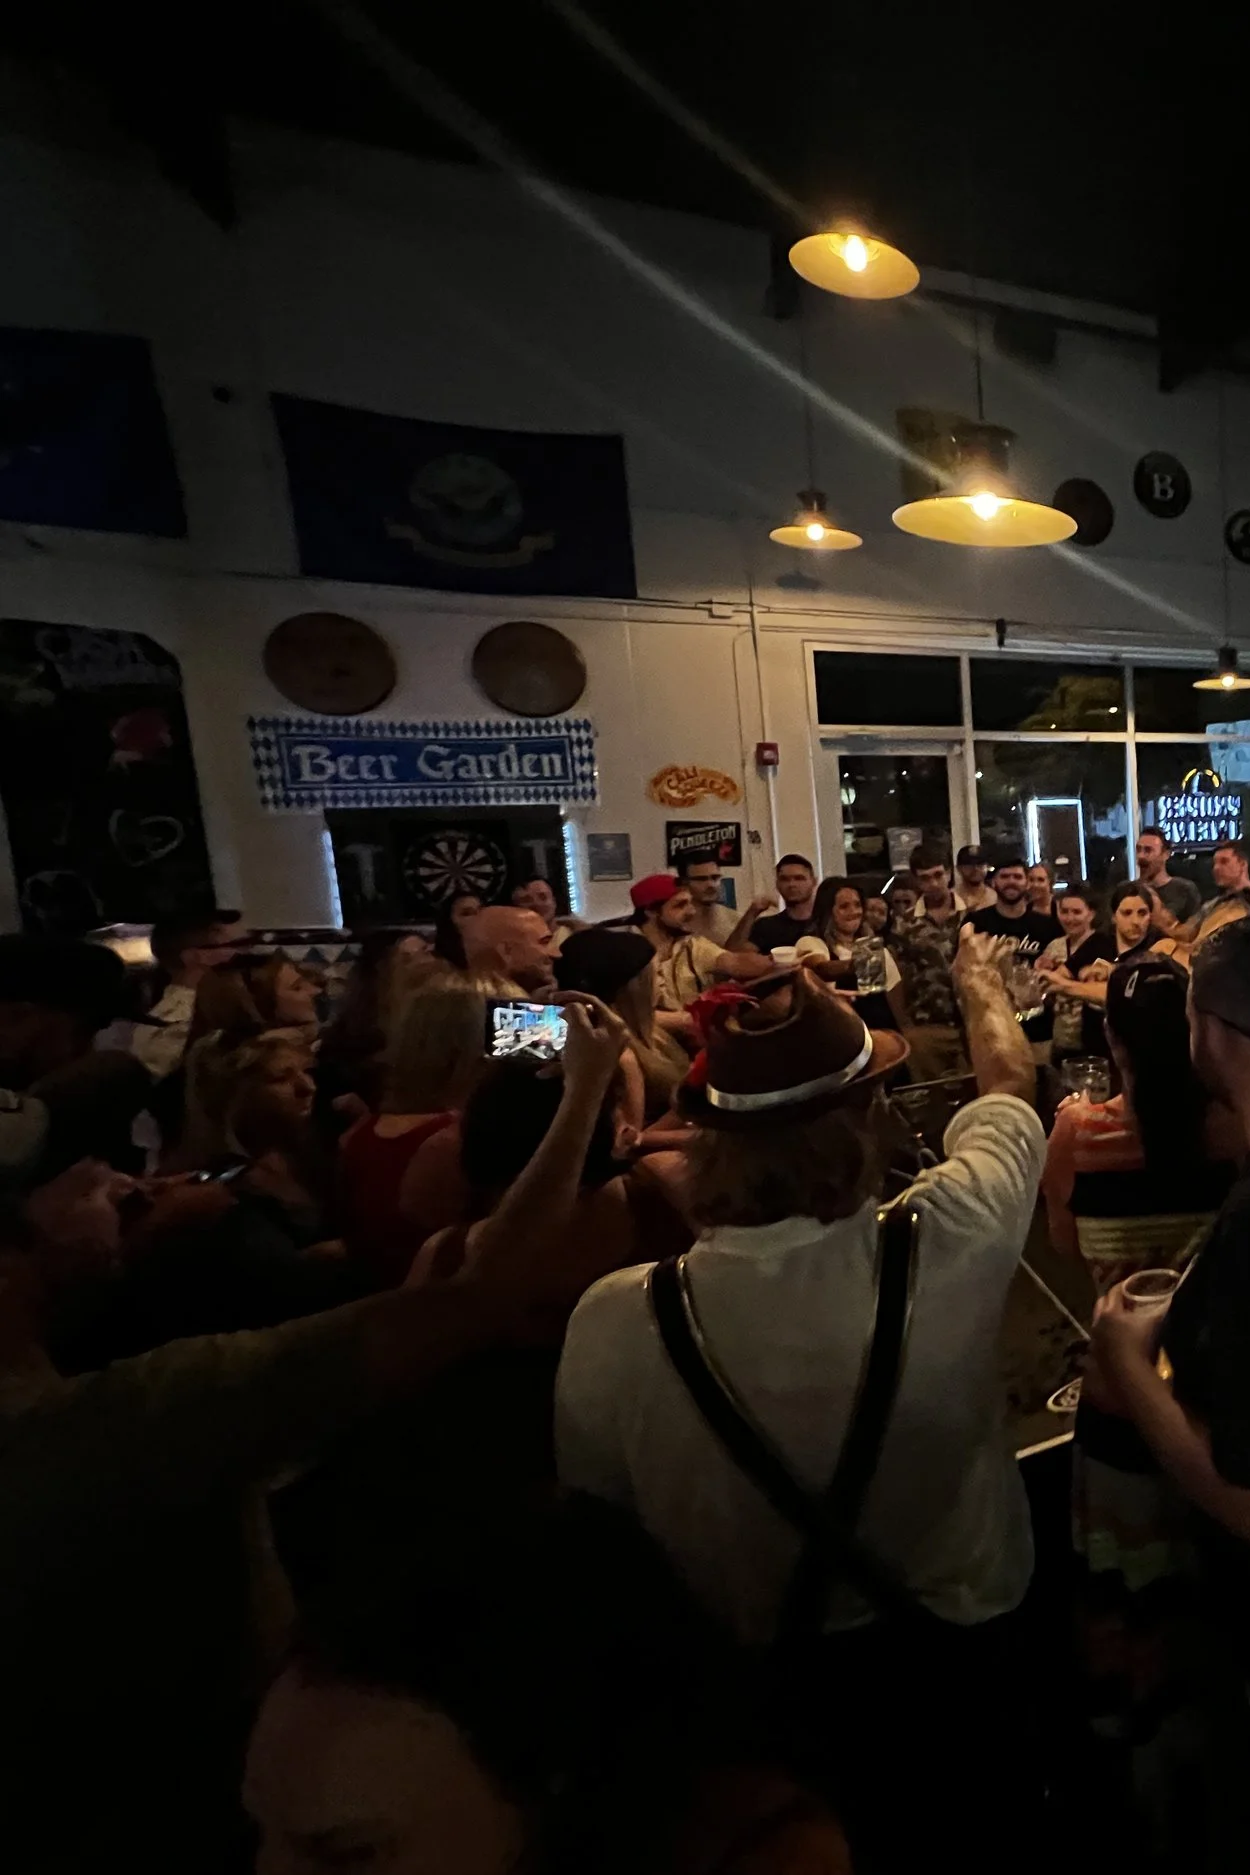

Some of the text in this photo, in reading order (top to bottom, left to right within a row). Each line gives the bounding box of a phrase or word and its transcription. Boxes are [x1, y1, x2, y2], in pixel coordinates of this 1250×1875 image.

[1153, 472, 1176, 501] B
[291, 743, 565, 783] Beer Garden
[669, 824, 738, 857] PENDLETON
